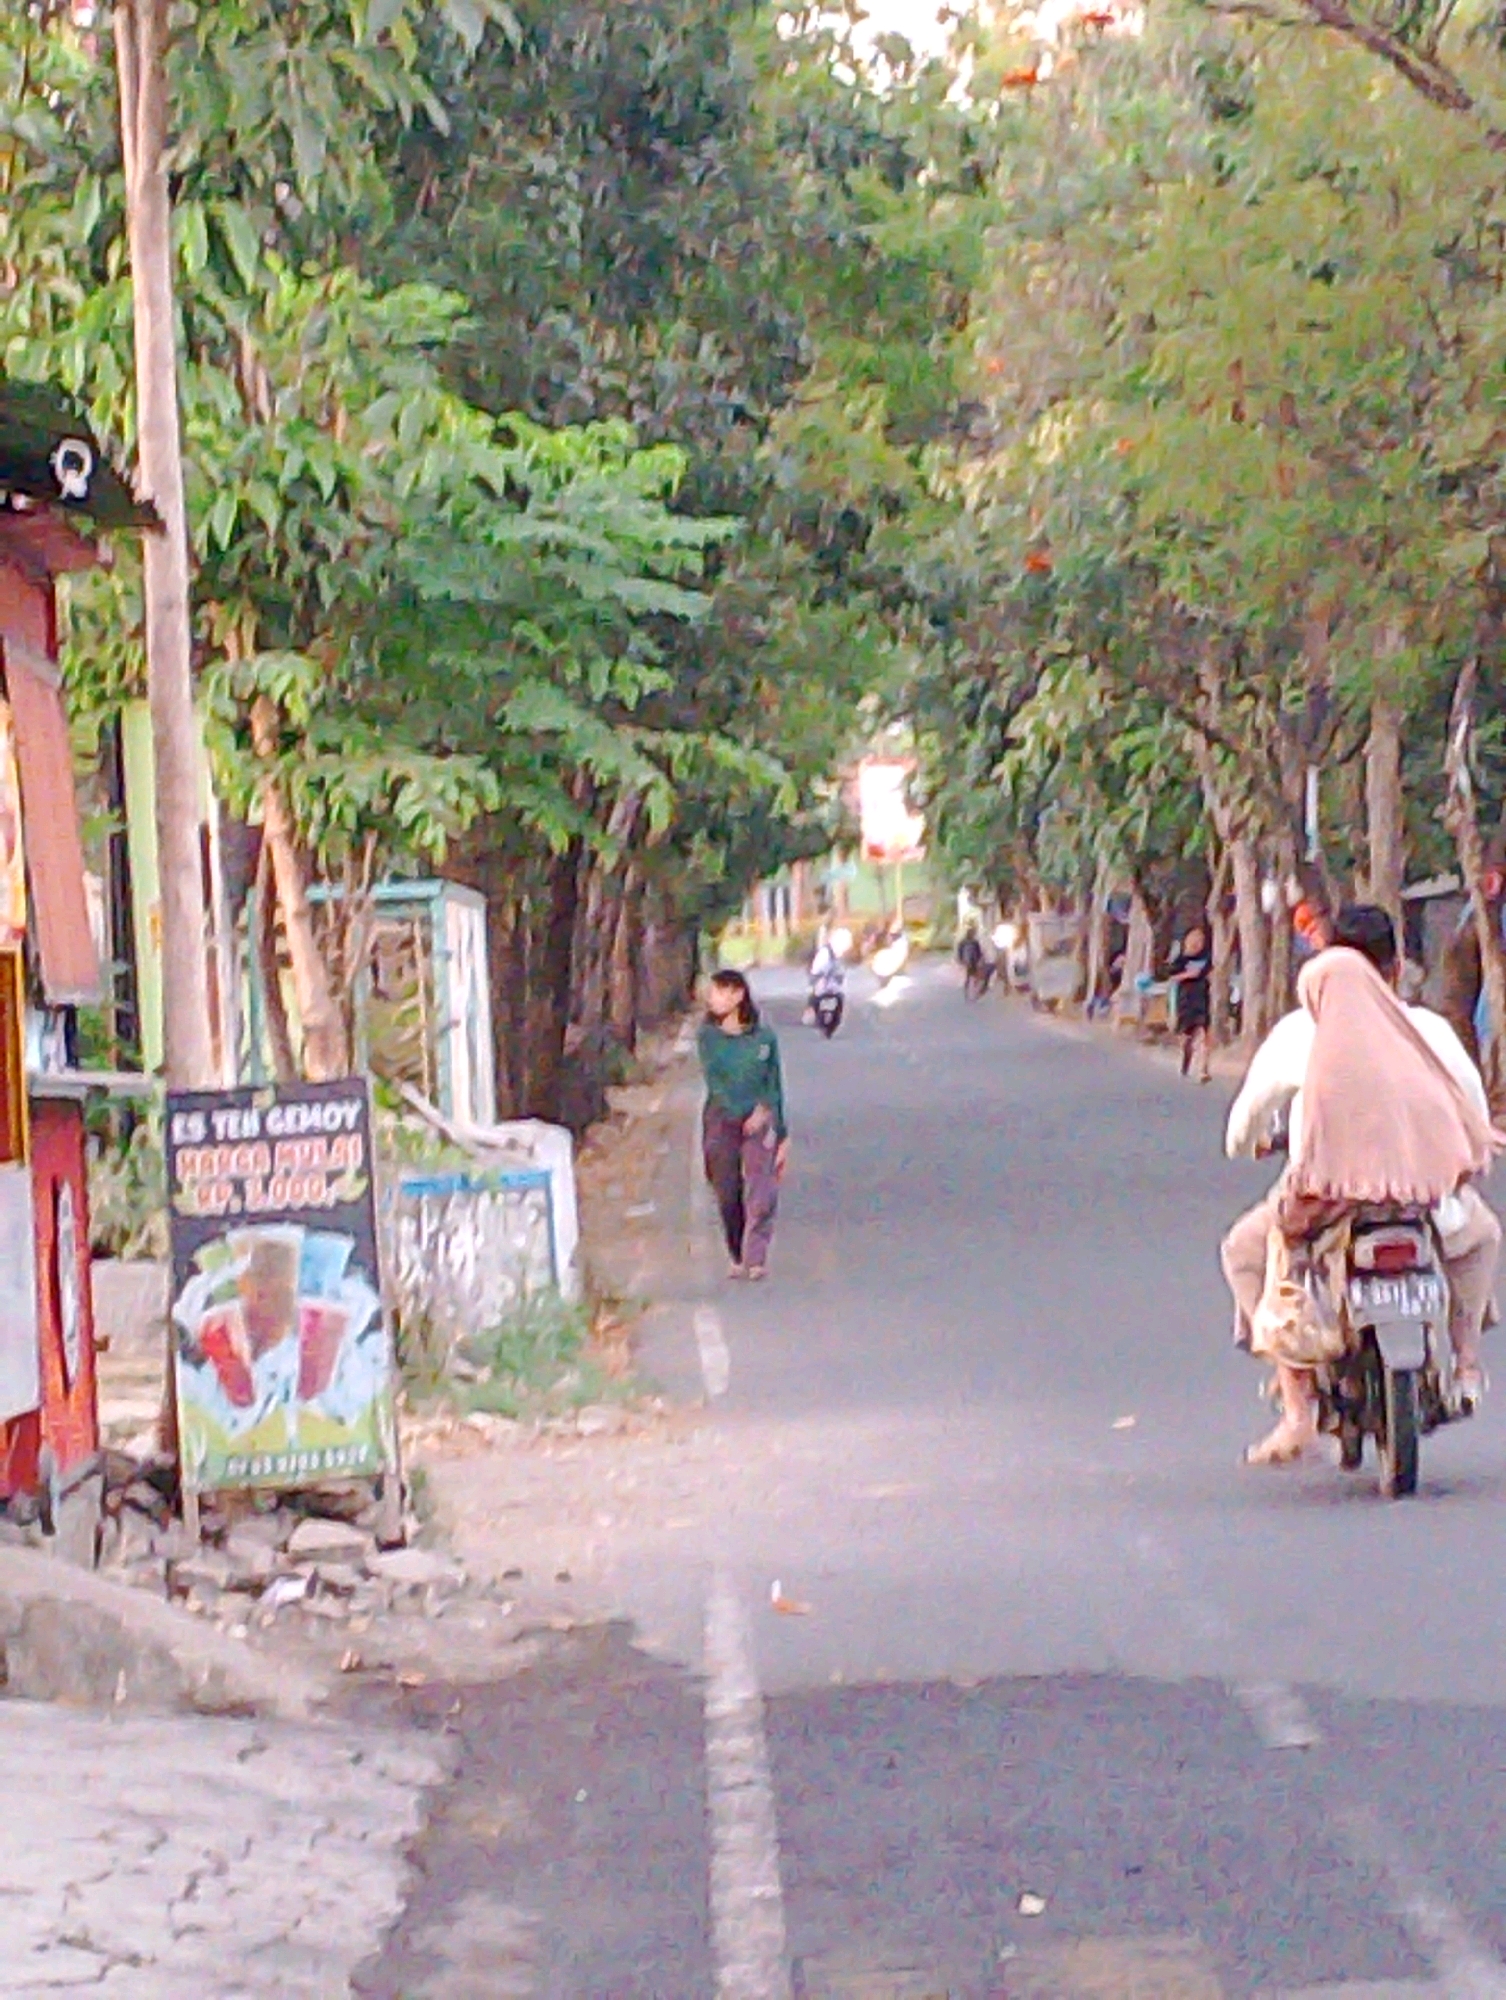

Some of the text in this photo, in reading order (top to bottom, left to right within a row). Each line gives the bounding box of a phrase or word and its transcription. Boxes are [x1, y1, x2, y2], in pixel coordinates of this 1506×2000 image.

[172, 1111, 207, 1145] ES
[211, 1106, 260, 1141] TEH
[175, 1141, 271, 1182] HARGA
